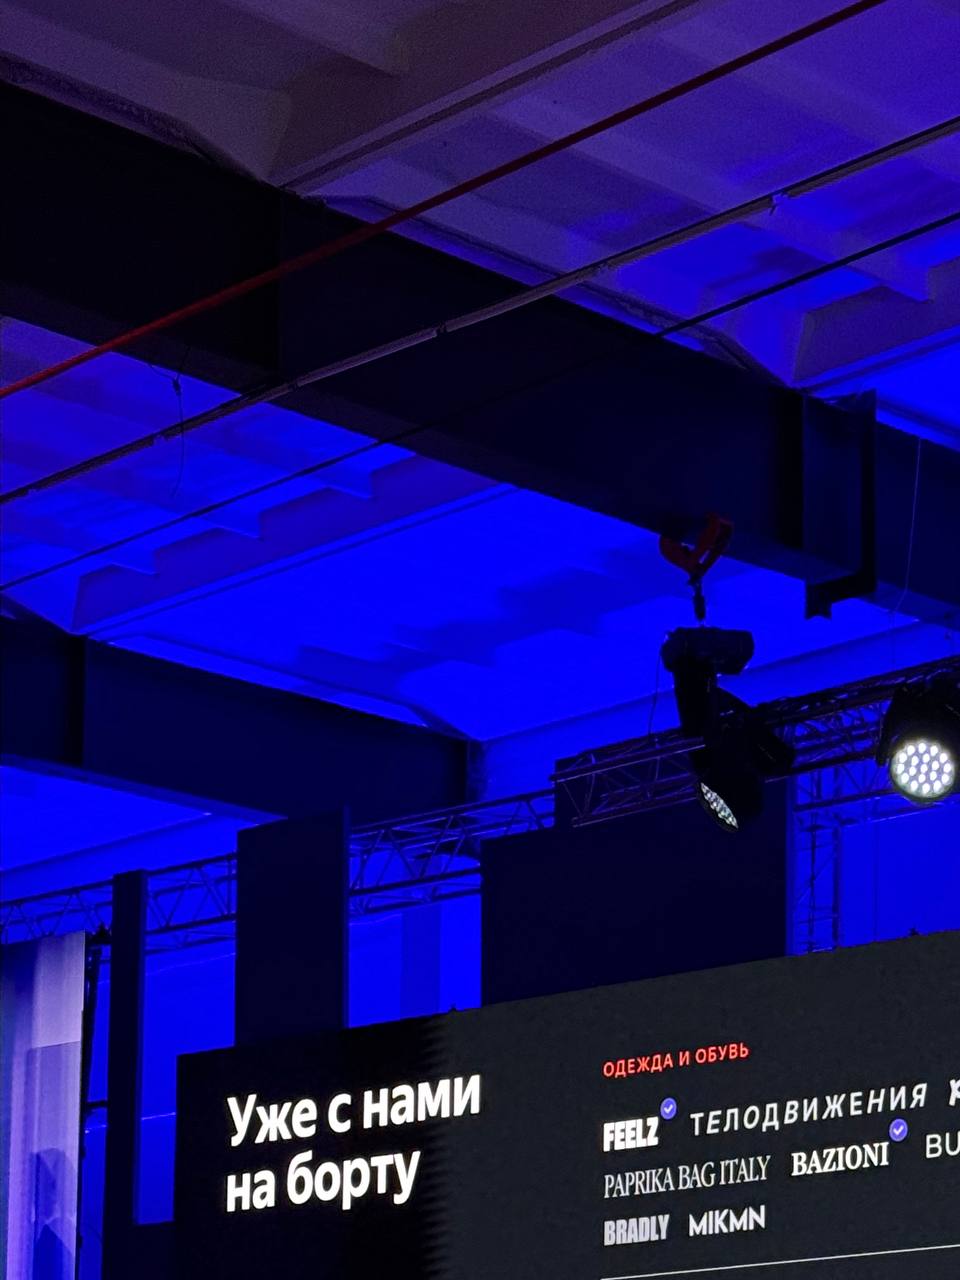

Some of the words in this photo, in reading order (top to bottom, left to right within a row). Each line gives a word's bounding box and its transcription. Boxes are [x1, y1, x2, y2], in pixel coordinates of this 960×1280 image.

[603, 1053, 674, 1079] ОДЕЖДА
[678, 1050, 690, 1067] И
[694, 1042, 749, 1064] ОБУВЬ
[226, 1093, 318, 1147] Уже
[327, 1093, 352, 1133] с
[363, 1074, 481, 1129] нами
[689, 1083, 928, 1136] ТЕЛОДВИЖЕНИЯ
[602, 1116, 660, 1152] FEELZ
[604, 1167, 675, 1199] PAPRIKA
[677, 1161, 716, 1190] BAG
[719, 1155, 771, 1185] ITALY
[791, 1141, 890, 1177] BAZIONI
[226, 1169, 276, 1213] на
[286, 1149, 421, 1211] борту
[603, 1214, 670, 1246] BRADLY
[688, 1204, 766, 1237] MIKMN
